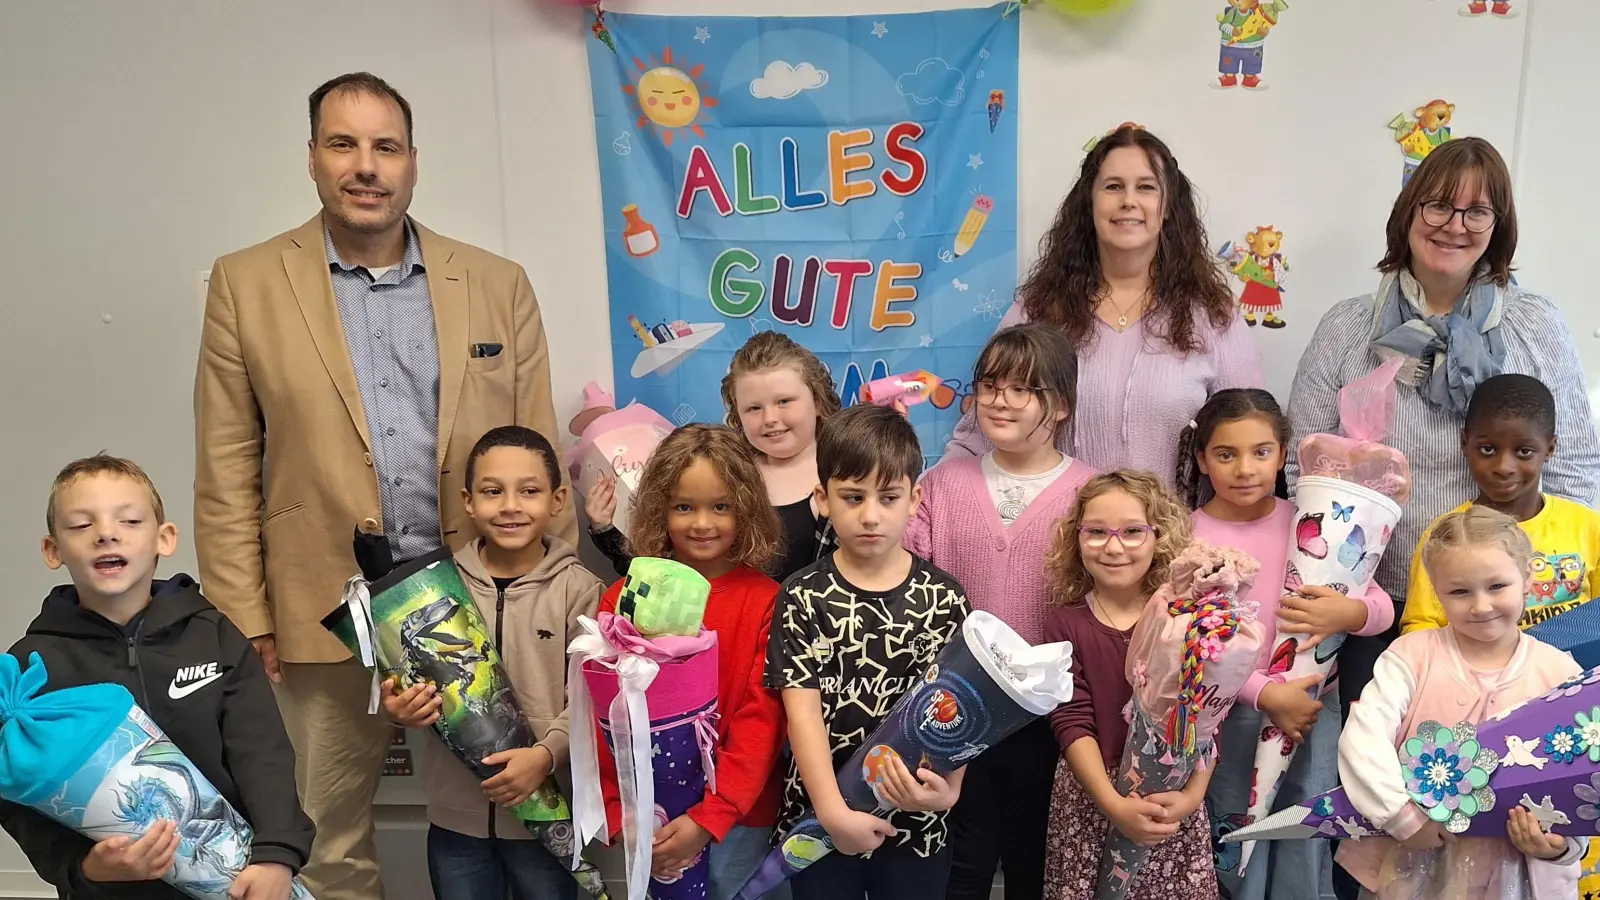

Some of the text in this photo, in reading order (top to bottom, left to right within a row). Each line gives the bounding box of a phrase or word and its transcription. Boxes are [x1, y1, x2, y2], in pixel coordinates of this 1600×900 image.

[676, 122, 926, 218] ALLES
[708, 248, 922, 330] GUTE
[175, 661, 218, 683] NIKE
[930, 713, 964, 730] ADVENTURE
[385, 756, 407, 764] cher
